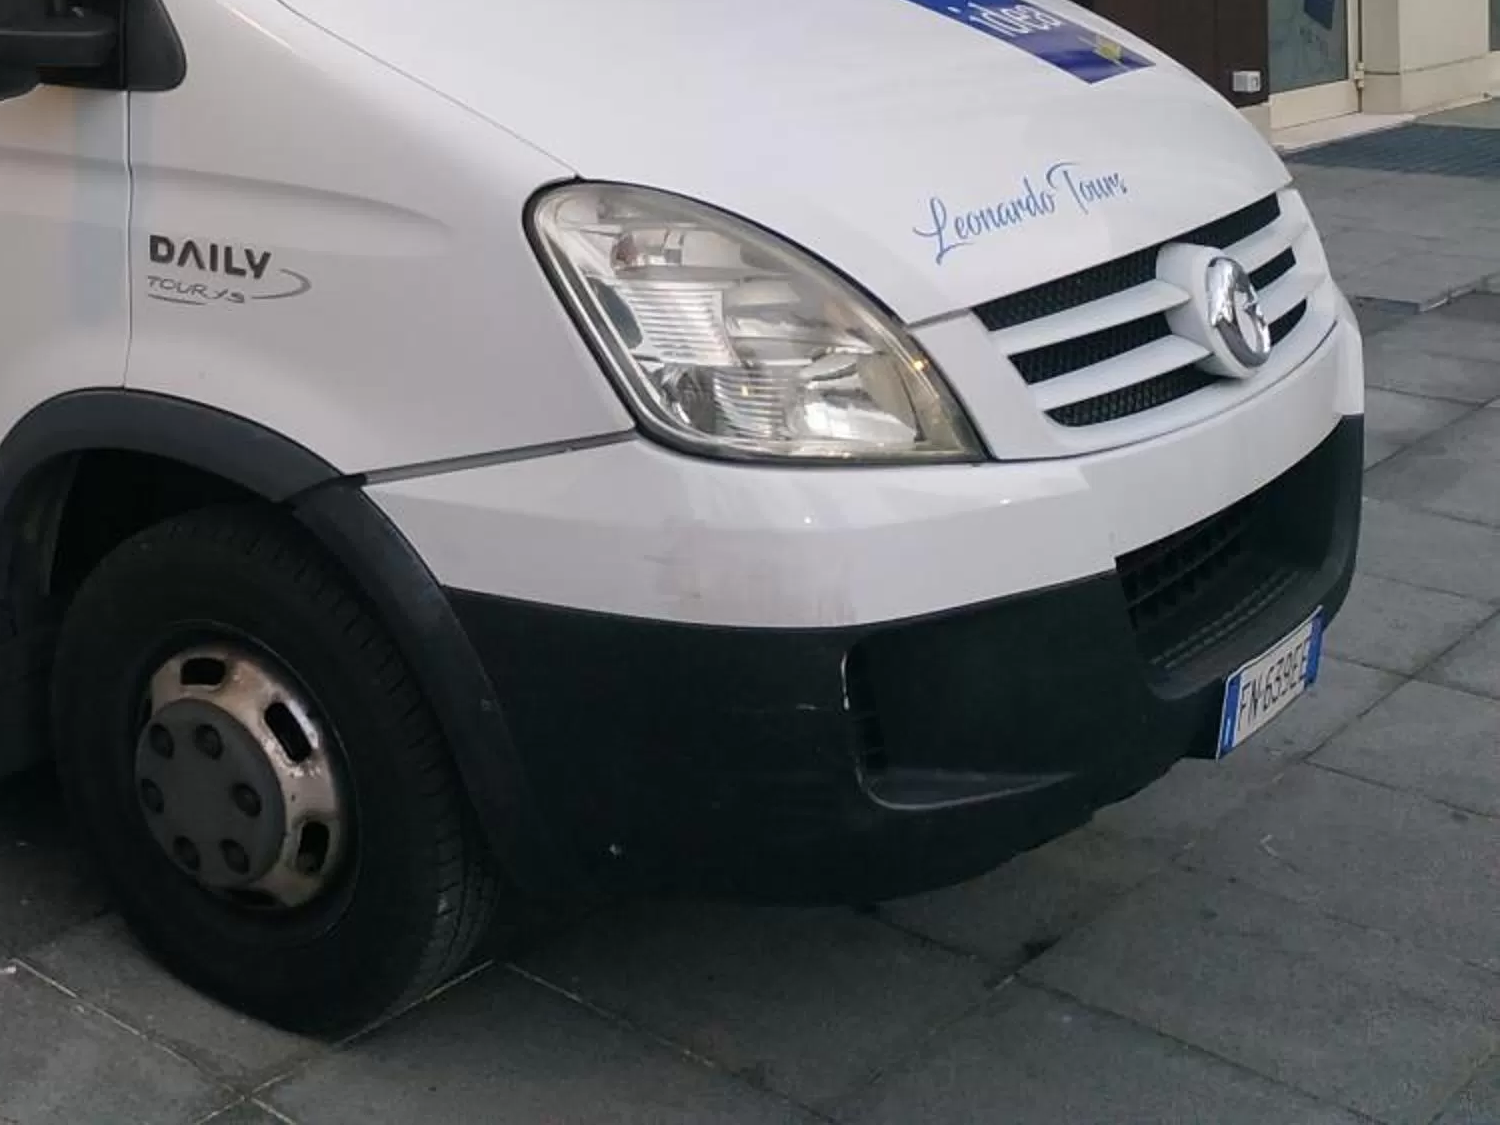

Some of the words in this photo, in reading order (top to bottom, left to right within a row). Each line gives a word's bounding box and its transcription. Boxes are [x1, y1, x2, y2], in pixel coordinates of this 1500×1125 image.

[911, 174, 1057, 267] Leonardo
[1045, 161, 1129, 215] Tours
[149, 234, 273, 280] DAILY
